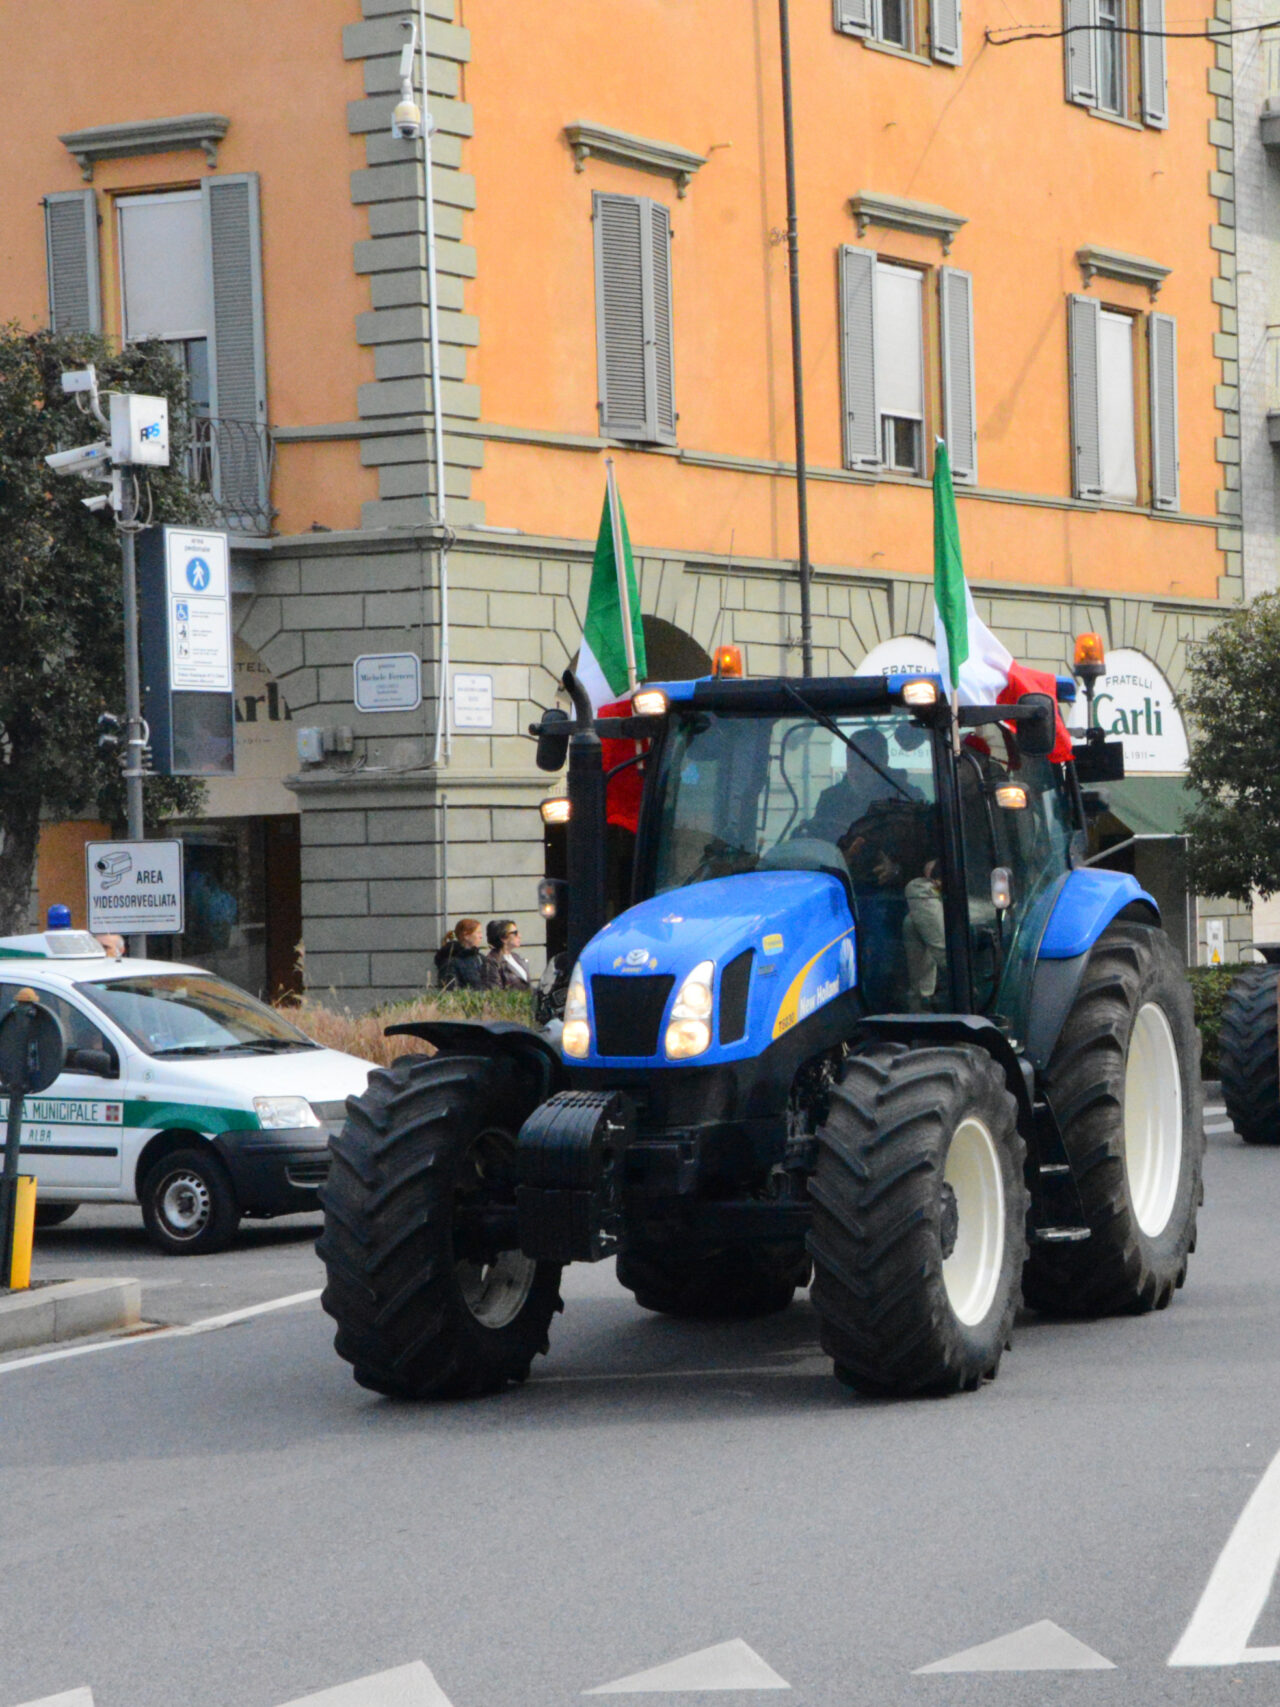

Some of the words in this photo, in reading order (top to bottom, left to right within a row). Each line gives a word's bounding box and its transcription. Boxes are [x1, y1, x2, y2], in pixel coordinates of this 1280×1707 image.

[1105, 674, 1153, 690] FRATELLI
[1092, 692, 1163, 736] Carli
[136, 870, 164, 884] AREA
[93, 894, 176, 909] VIDEOSORVEGLIATA
[33, 1102, 98, 1122] MUNICIPALE
[28, 1129, 52, 1142] ALBA
